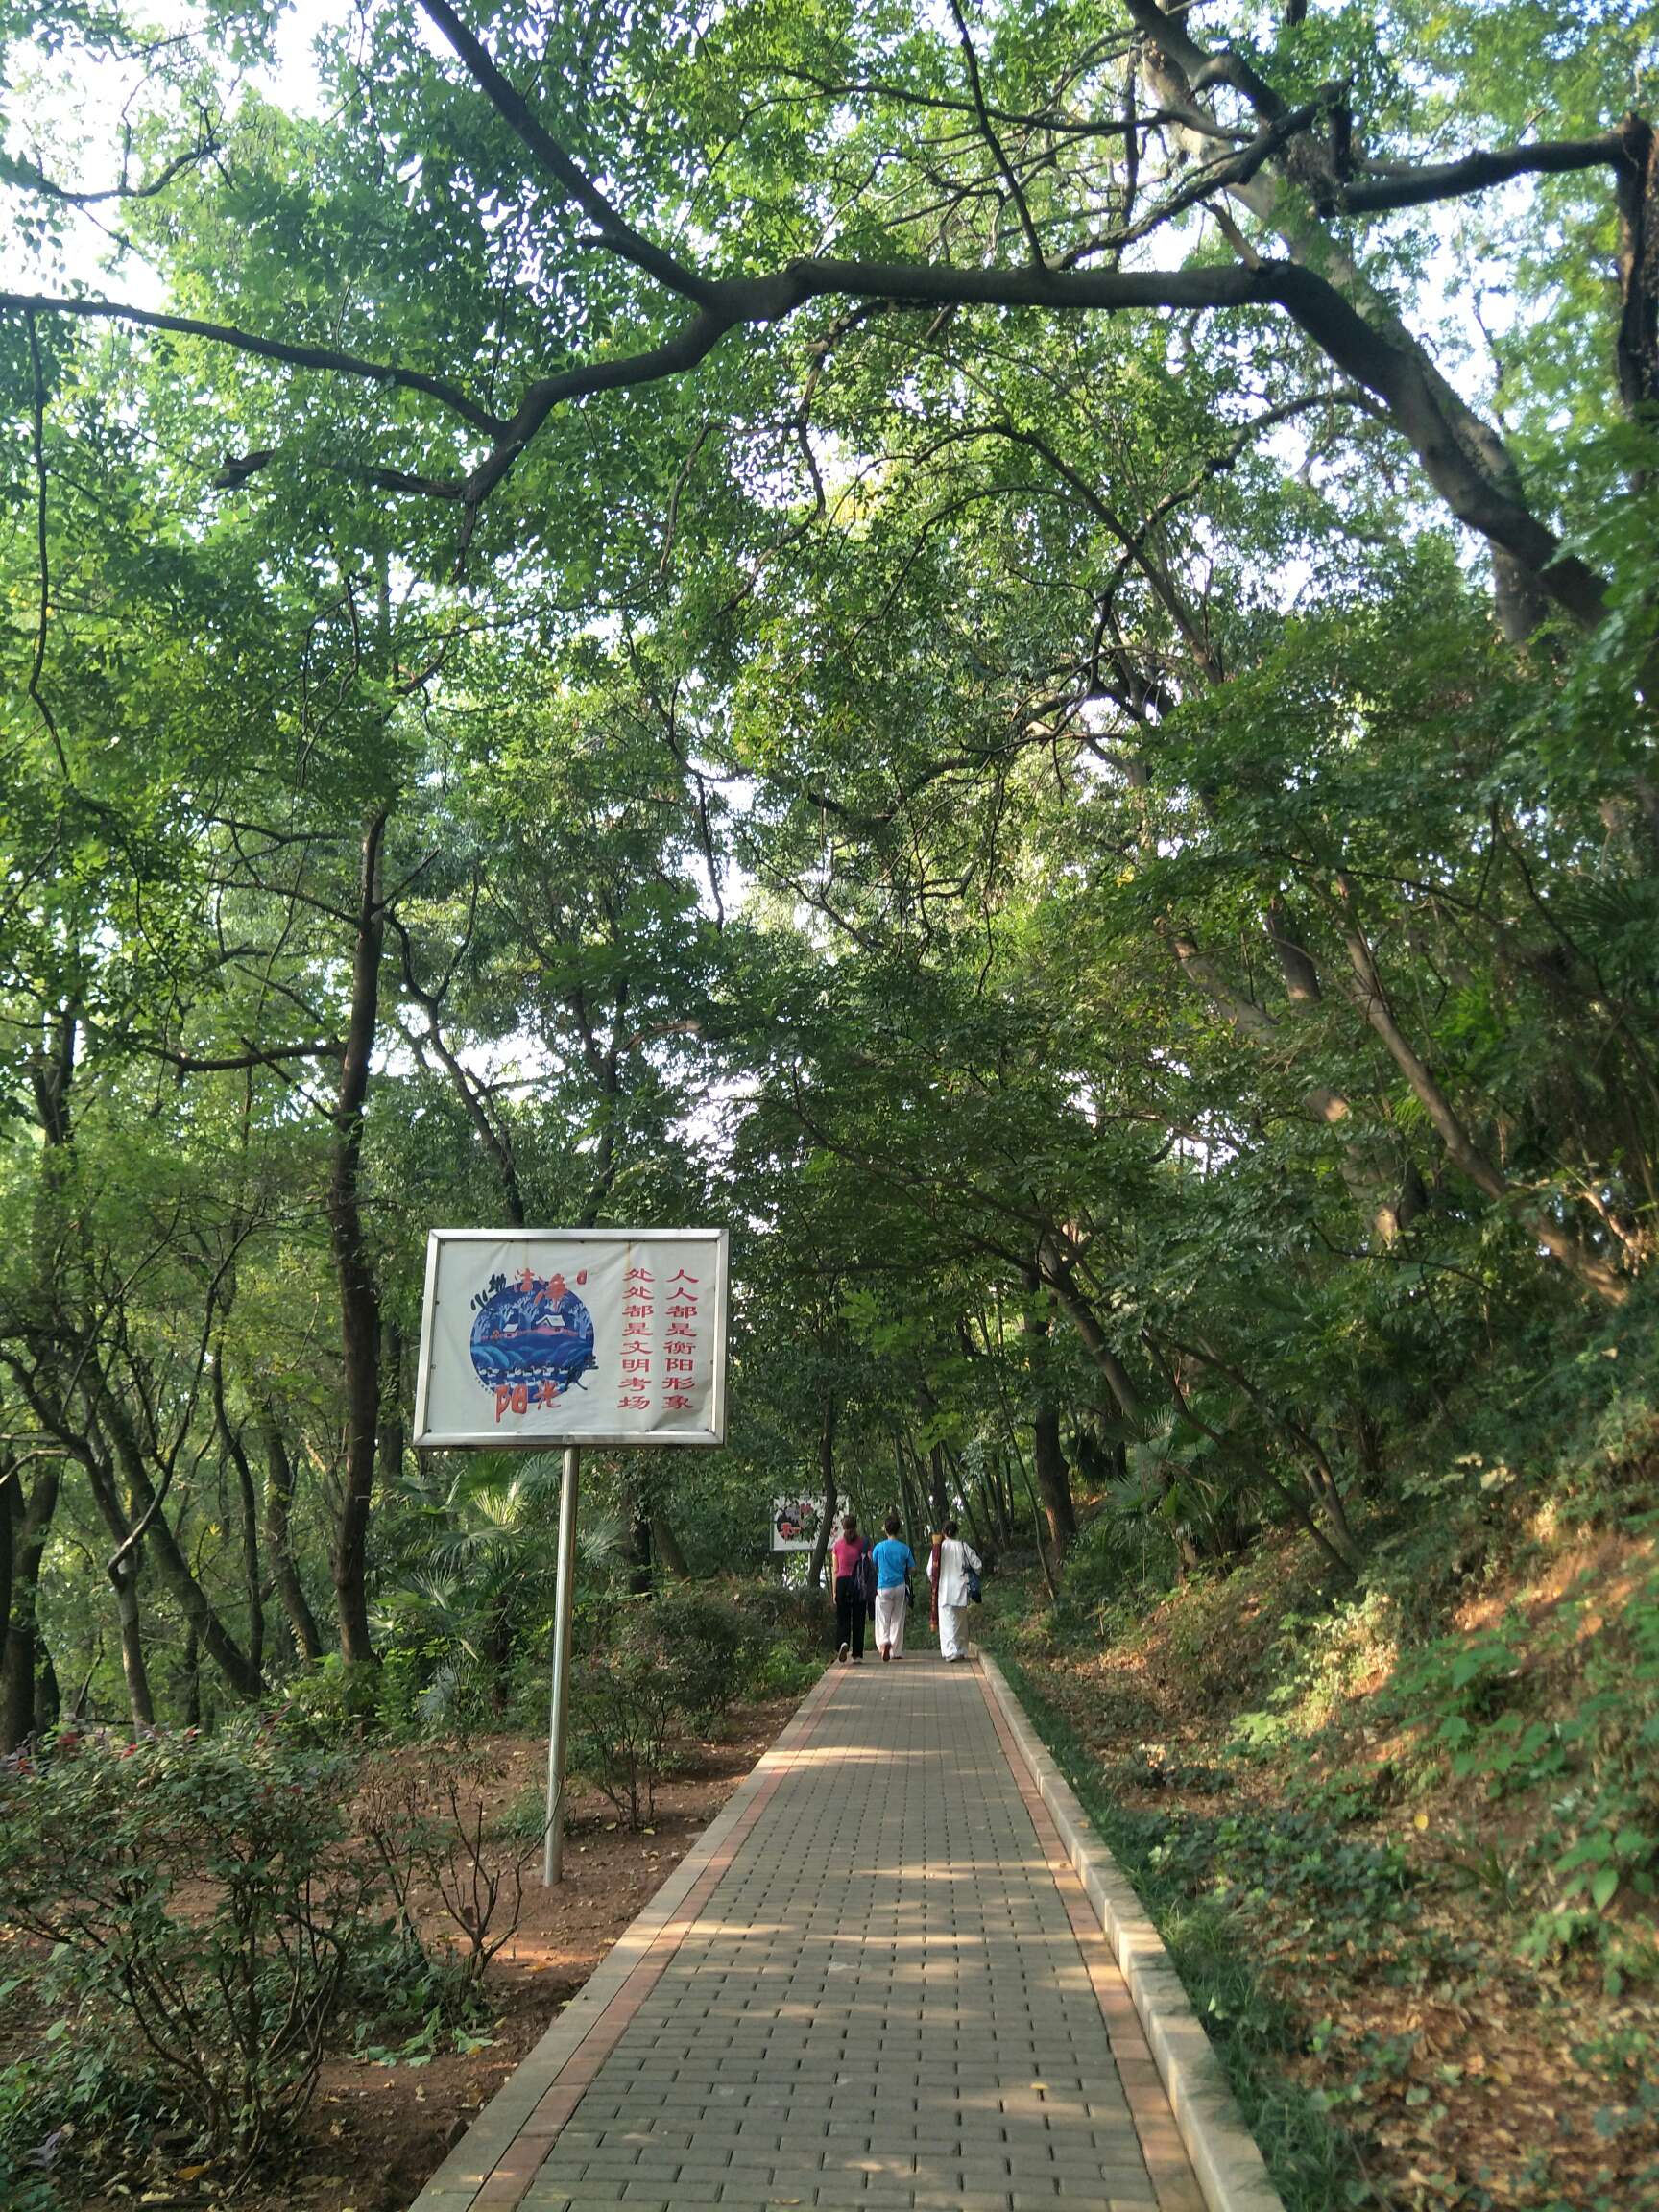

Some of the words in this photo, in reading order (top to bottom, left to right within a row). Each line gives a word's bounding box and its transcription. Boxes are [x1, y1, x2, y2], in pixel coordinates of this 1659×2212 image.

[616, 1267, 656, 1410] 处处都是文明考场
[661, 1268, 700, 1410] 人人都是衡阳形象
